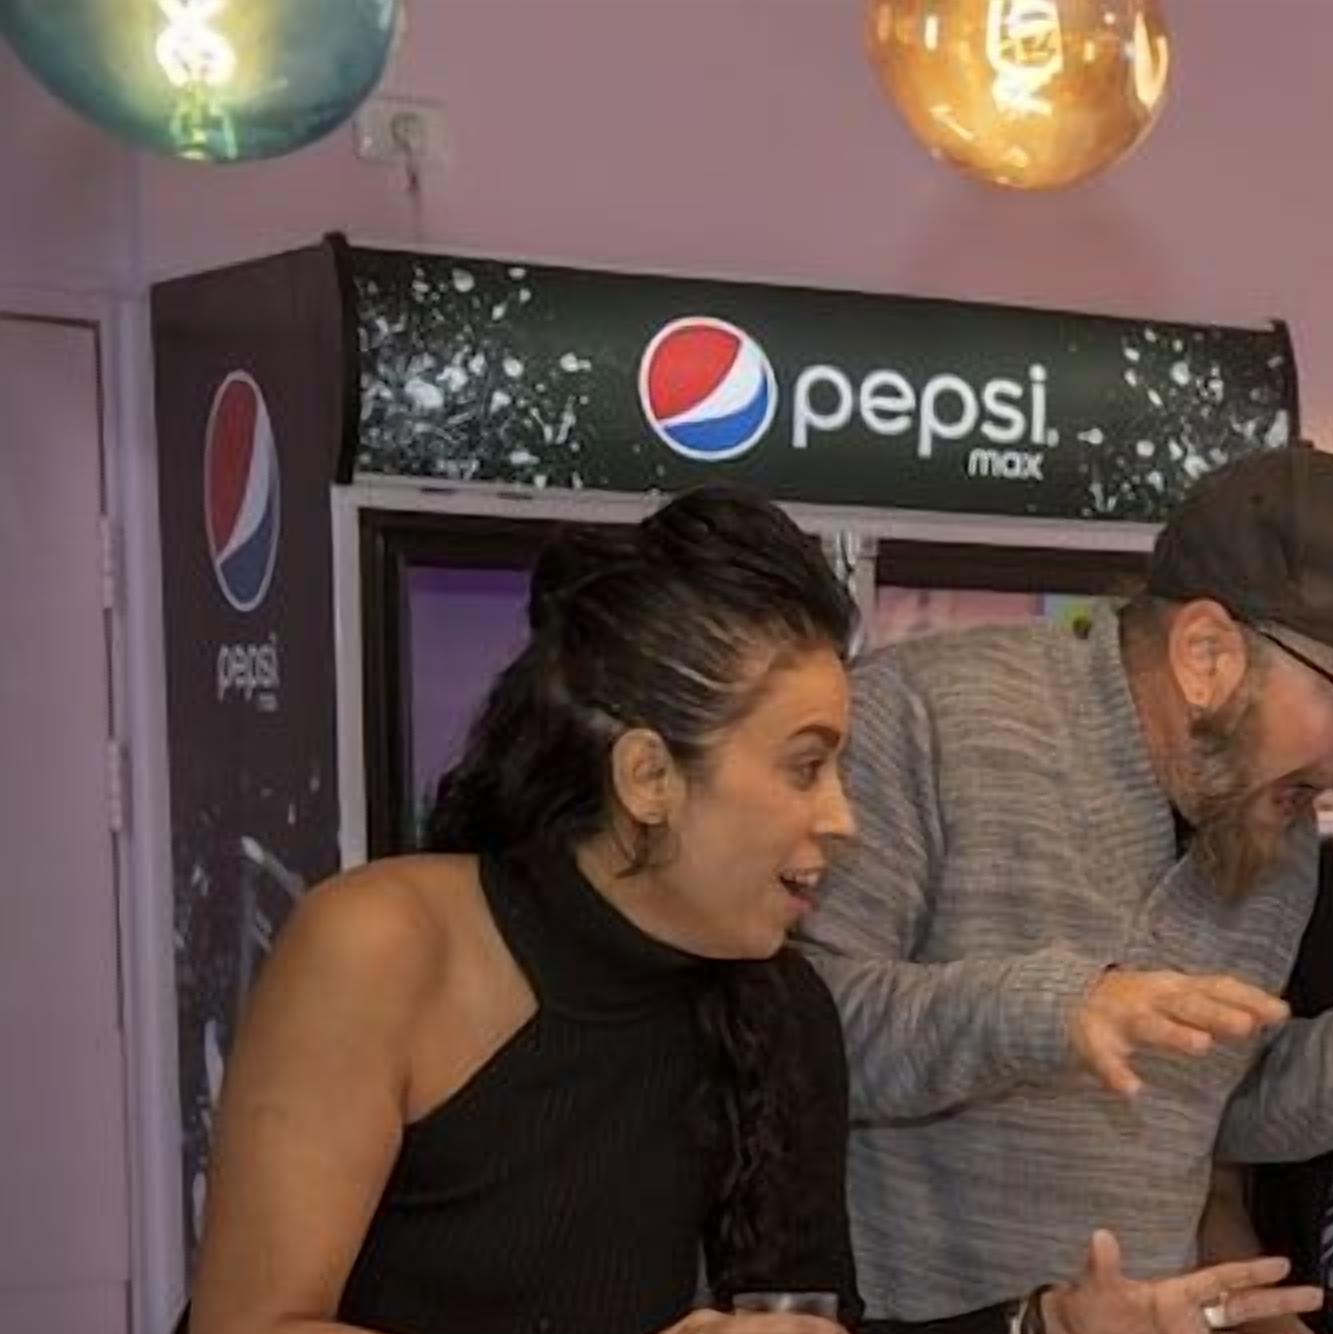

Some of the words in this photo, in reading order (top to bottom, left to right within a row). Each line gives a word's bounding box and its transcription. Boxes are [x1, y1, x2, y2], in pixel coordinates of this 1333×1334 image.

[792, 363, 1048, 458] pepsi
[967, 448, 1044, 480] max
[218, 632, 280, 701] pepsi
